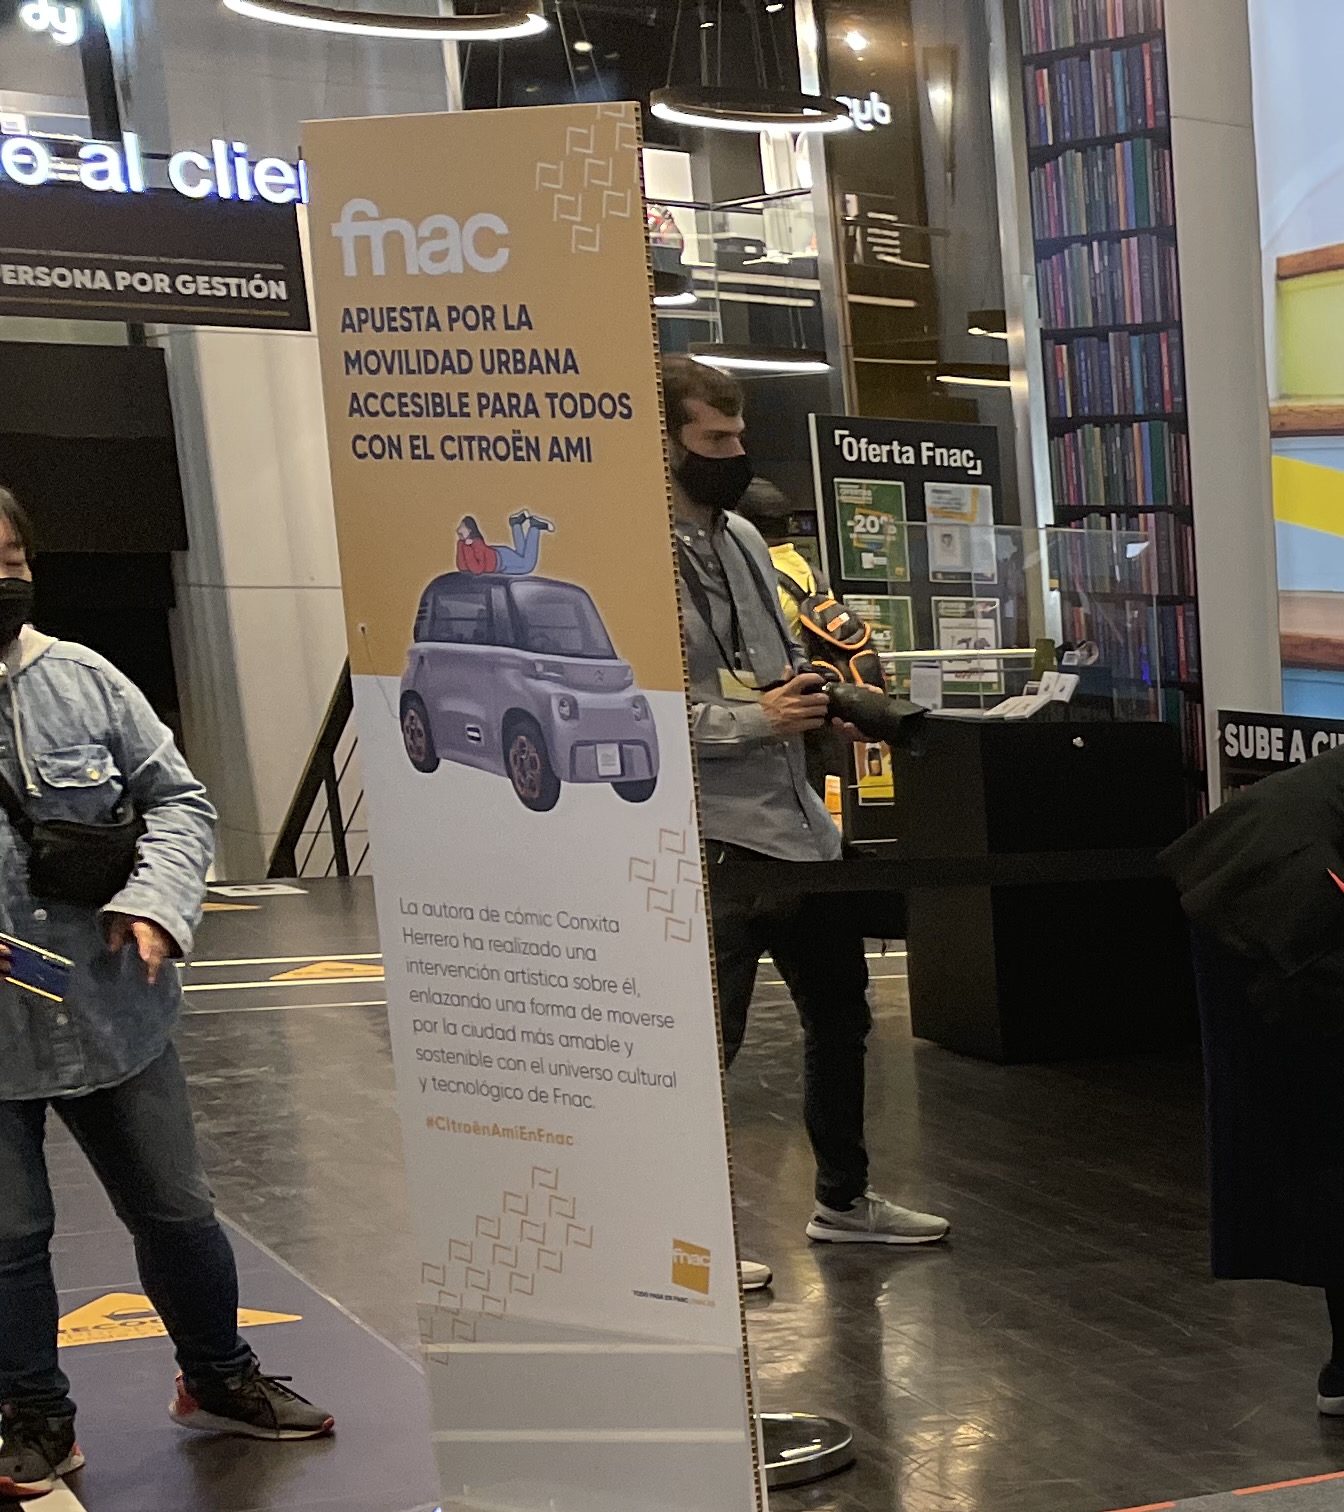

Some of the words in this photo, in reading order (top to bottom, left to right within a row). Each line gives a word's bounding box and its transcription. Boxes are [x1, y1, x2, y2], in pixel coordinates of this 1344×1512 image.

[1, 138, 49, 187] o
[78, 132, 145, 194] al
[332, 200, 509, 277] fnac
[115, 271, 171, 294] POR
[175, 274, 287, 301] GESTIÓN
[341, 306, 440, 333] APUESTA
[448, 305, 495, 332] POR
[503, 303, 532, 331] LA
[344, 348, 473, 376] MOVILIDAD
[479, 348, 578, 376] URBANA
[348, 391, 470, 419] ACCESIBLE
[477, 392, 540, 419] PARA
[548, 391, 633, 419] TODOS
[352, 433, 402, 460] CON
[410, 434, 435, 461] EL
[440, 429, 540, 463] CITROËN
[548, 435, 592, 463] AMI
[842, 435, 916, 465] Oferta
[921, 441, 975, 469] Fnac
[1224, 722, 1285, 761] SUBE
[1289, 729, 1307, 763] A
[399, 897, 418, 917] La
[422, 901, 474, 921] autora
[479, 903, 500, 923] de
[504, 907, 552, 926] cómic
[557, 911, 620, 934] Conxita
[403, 928, 459, 949] Herrero
[463, 931, 484, 951] ha
[489, 936, 561, 959] realizado
[566, 944, 597, 962] una
[406, 959, 500, 982] intervención
[573, 974, 618, 995] sobre
[409, 987, 491, 1011] enlazando
[496, 997, 526, 1014] una
[530, 997, 577, 1019] forma
[581, 1002, 602, 1022] de
[608, 1007, 675, 1029] moverse
[413, 1017, 438, 1035] por
[443, 1016, 458, 1036] la
[462, 1021, 516, 1043] ciudad
[521, 1026, 555, 1047] más
[559, 1030, 620, 1053] amable
[624, 1039, 634, 1058] y
[416, 1047, 493, 1069] sostenible
[497, 1055, 527, 1074] con
[531, 1055, 545, 1075] el
[548, 1061, 612, 1082] universo
[618, 1064, 678, 1089] cultural
[419, 1076, 427, 1093] y
[432, 1076, 524, 1102] tecnológico
[528, 1085, 549, 1103] de
